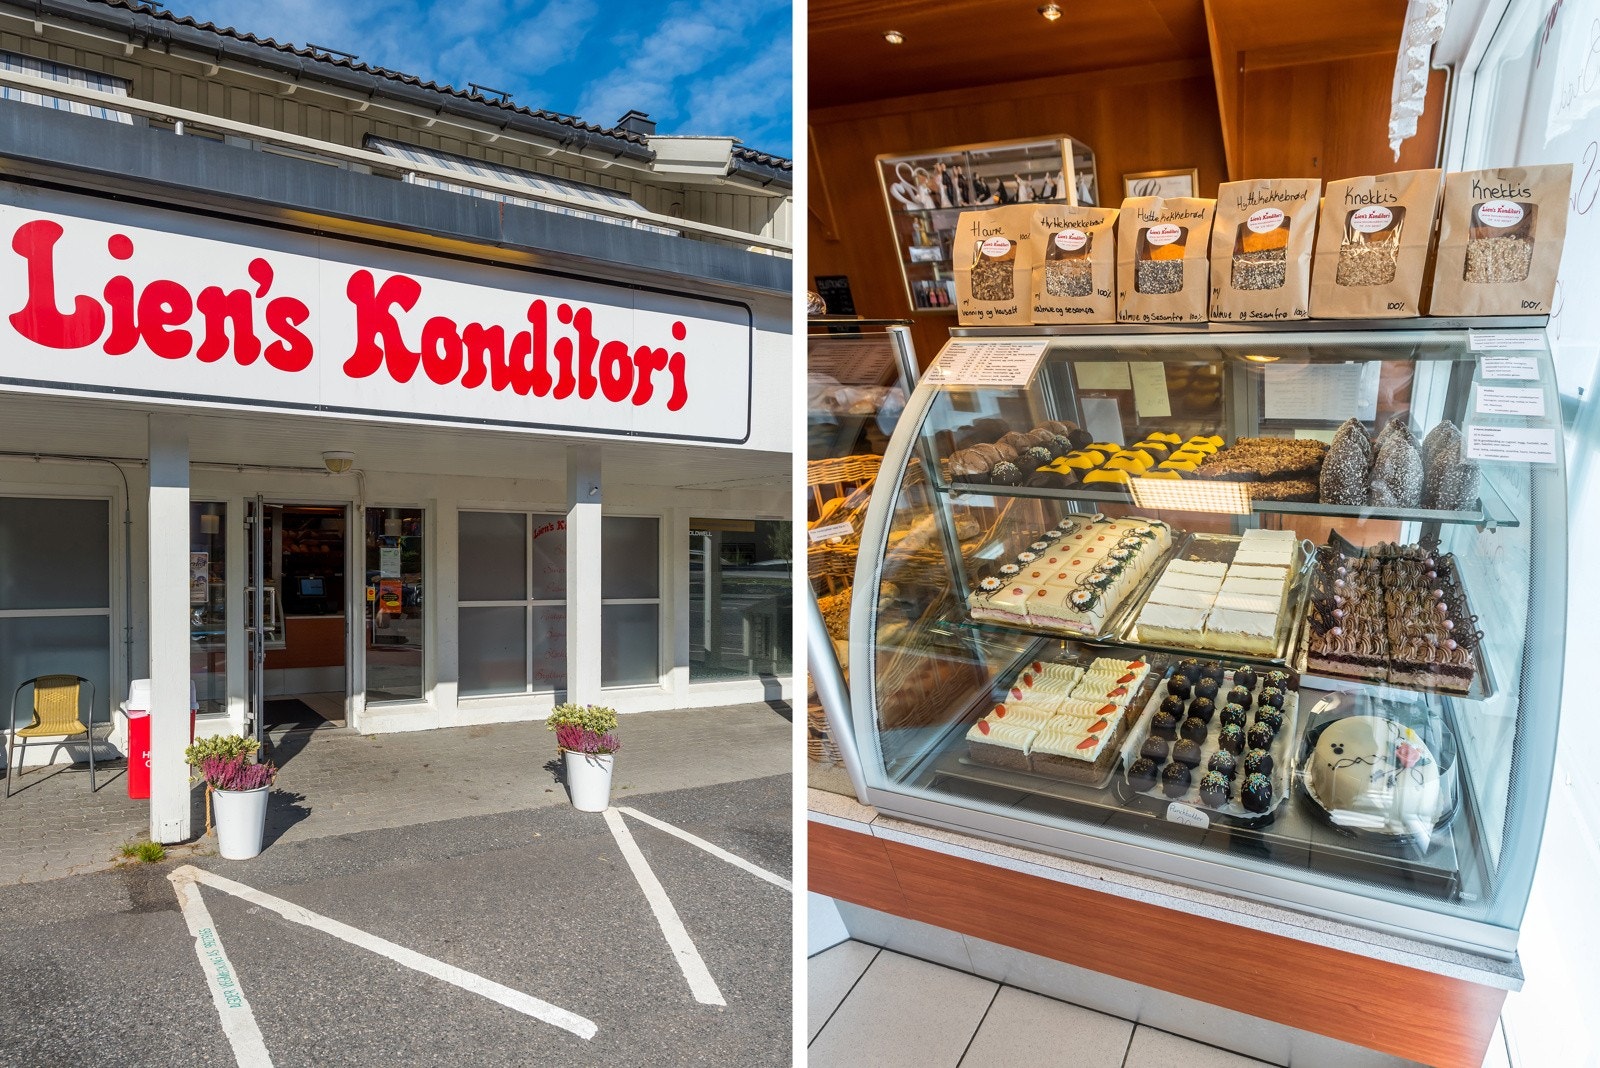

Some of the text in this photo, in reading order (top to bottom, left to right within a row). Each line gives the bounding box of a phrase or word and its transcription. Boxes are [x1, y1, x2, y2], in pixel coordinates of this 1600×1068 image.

[1344, 185, 1398, 205] Knekkis
[1472, 178, 1532, 200] Knekkis
[1097, 288, 1112, 298] 100%
[1055, 306, 1064, 317] og
[1387, 302, 1405, 311] 100%
[9, 219, 689, 412] Lien's Konditori
[985, 309, 994, 319] og
[533, 521, 555, 539] Lien's
